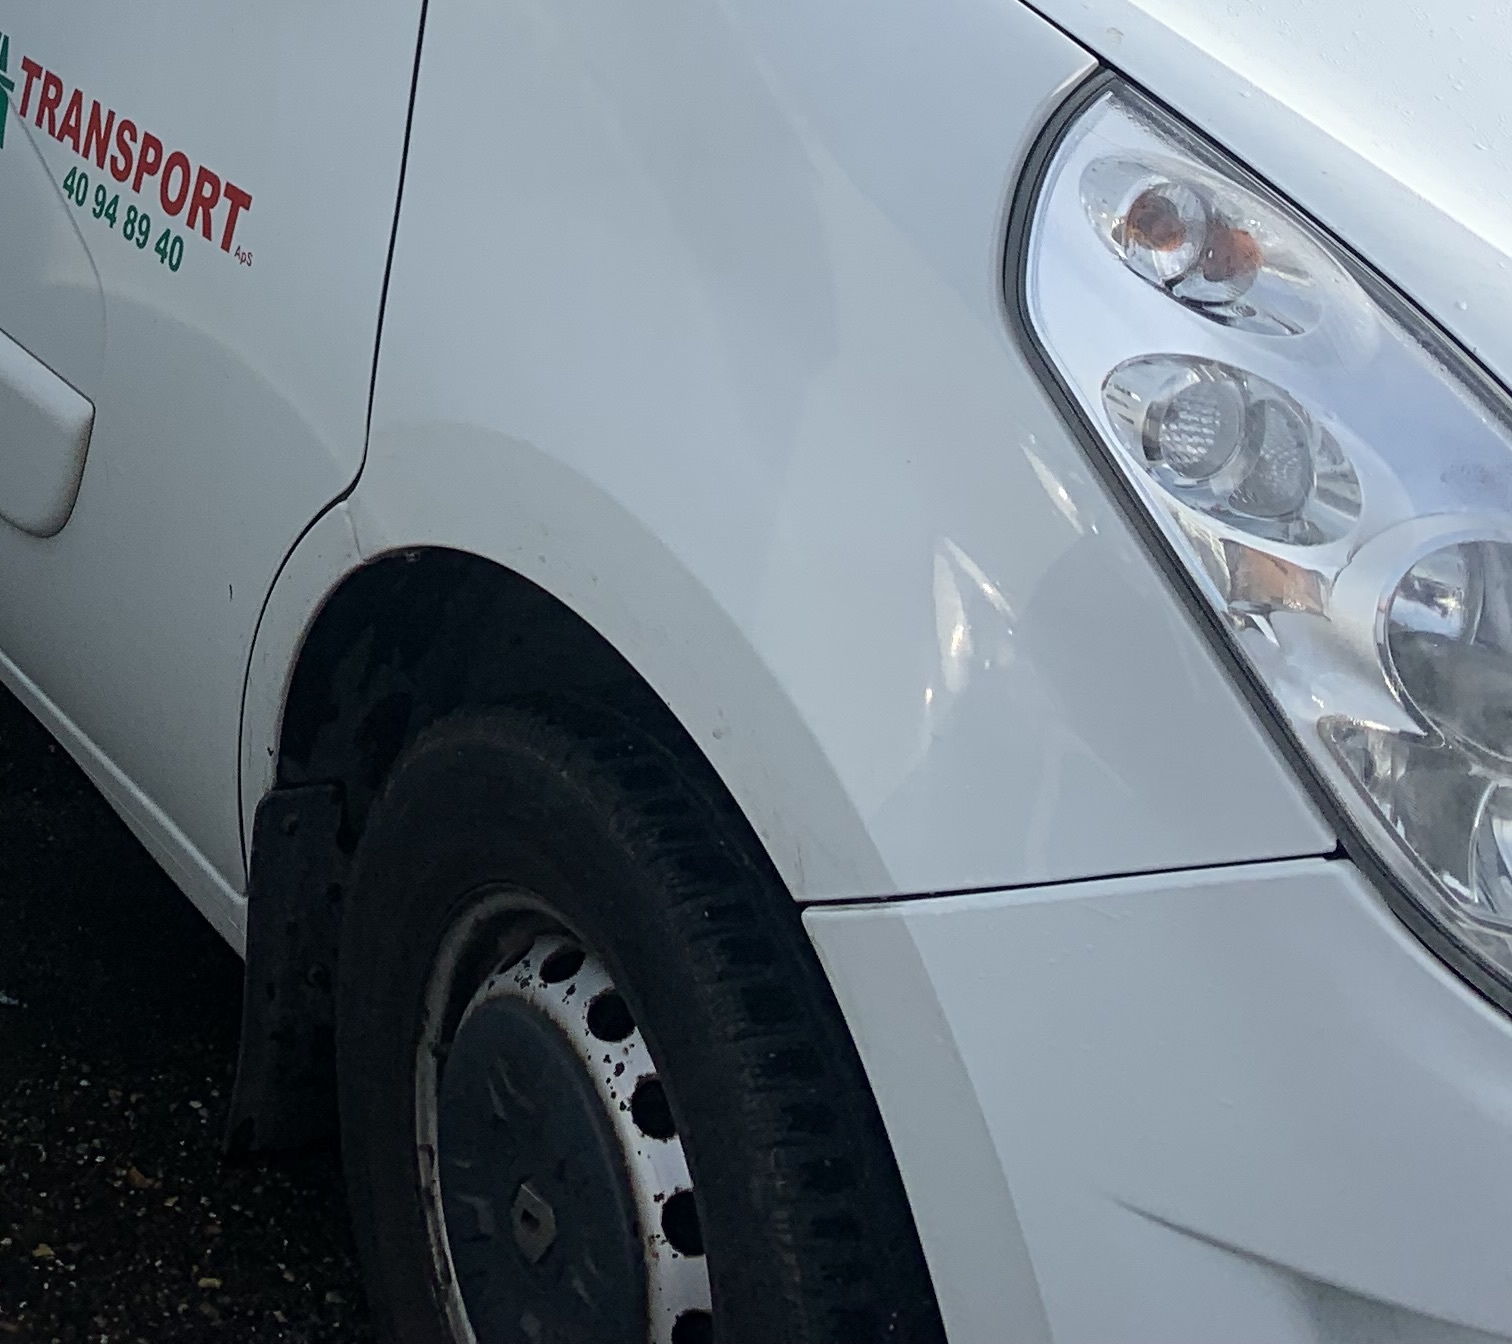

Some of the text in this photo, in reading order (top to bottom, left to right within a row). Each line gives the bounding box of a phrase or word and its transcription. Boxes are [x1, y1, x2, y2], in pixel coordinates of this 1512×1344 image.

[19, 56, 252, 253] TRANSPORT
[234, 245, 253, 267] ApS
[62, 166, 184, 272] 40 94 89 40
